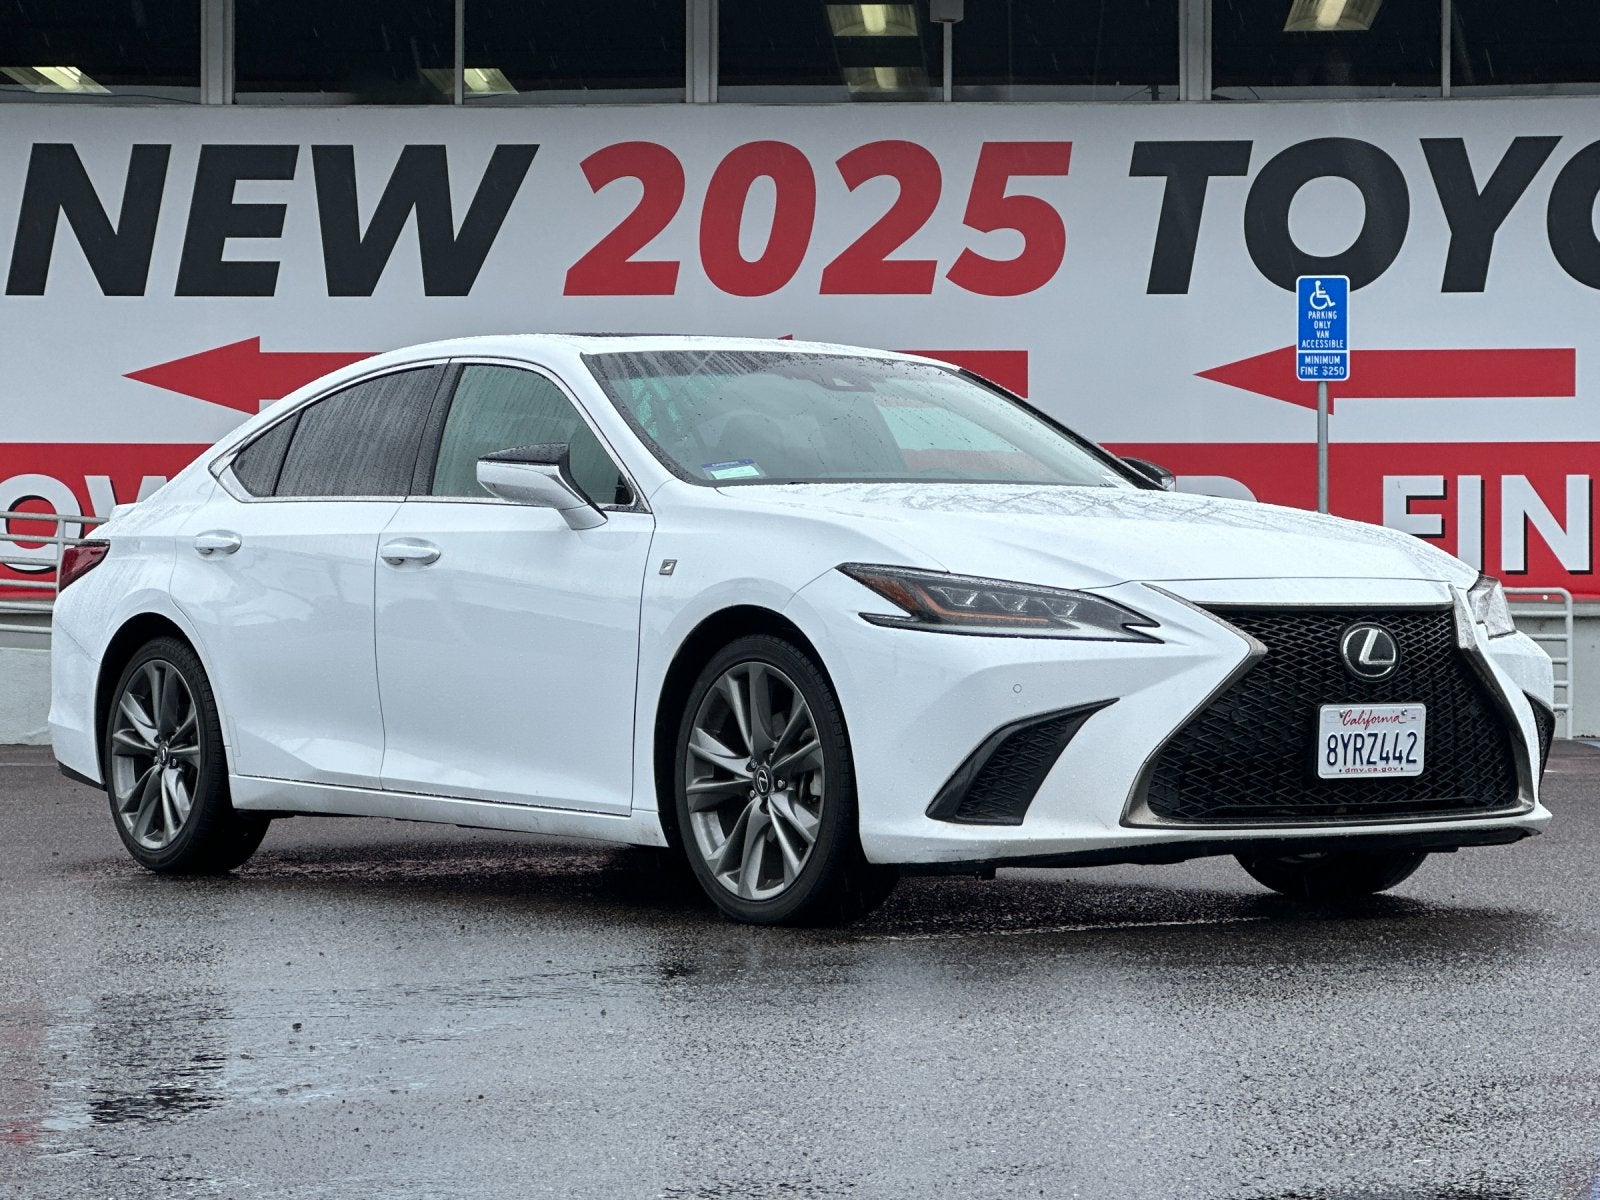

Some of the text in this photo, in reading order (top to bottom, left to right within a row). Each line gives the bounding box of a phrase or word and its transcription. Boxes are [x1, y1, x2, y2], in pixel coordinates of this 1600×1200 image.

[5, 143, 540, 297] NEW
[563, 140, 1073, 296] 2025
[1308, 310, 1337, 320] PARKING
[1313, 320, 1331, 329] ONLY
[1316, 330, 1330, 339] VAN
[1301, 339, 1344, 349] ACCESSIBLE
[1304, 355, 1341, 365] MINIMUM
[1300, 366, 1345, 376] FINE $250
[1382, 474, 1592, 574] FIN
[1342, 709, 1407, 731] California
[1326, 731, 1418, 767] 8YRZ442
